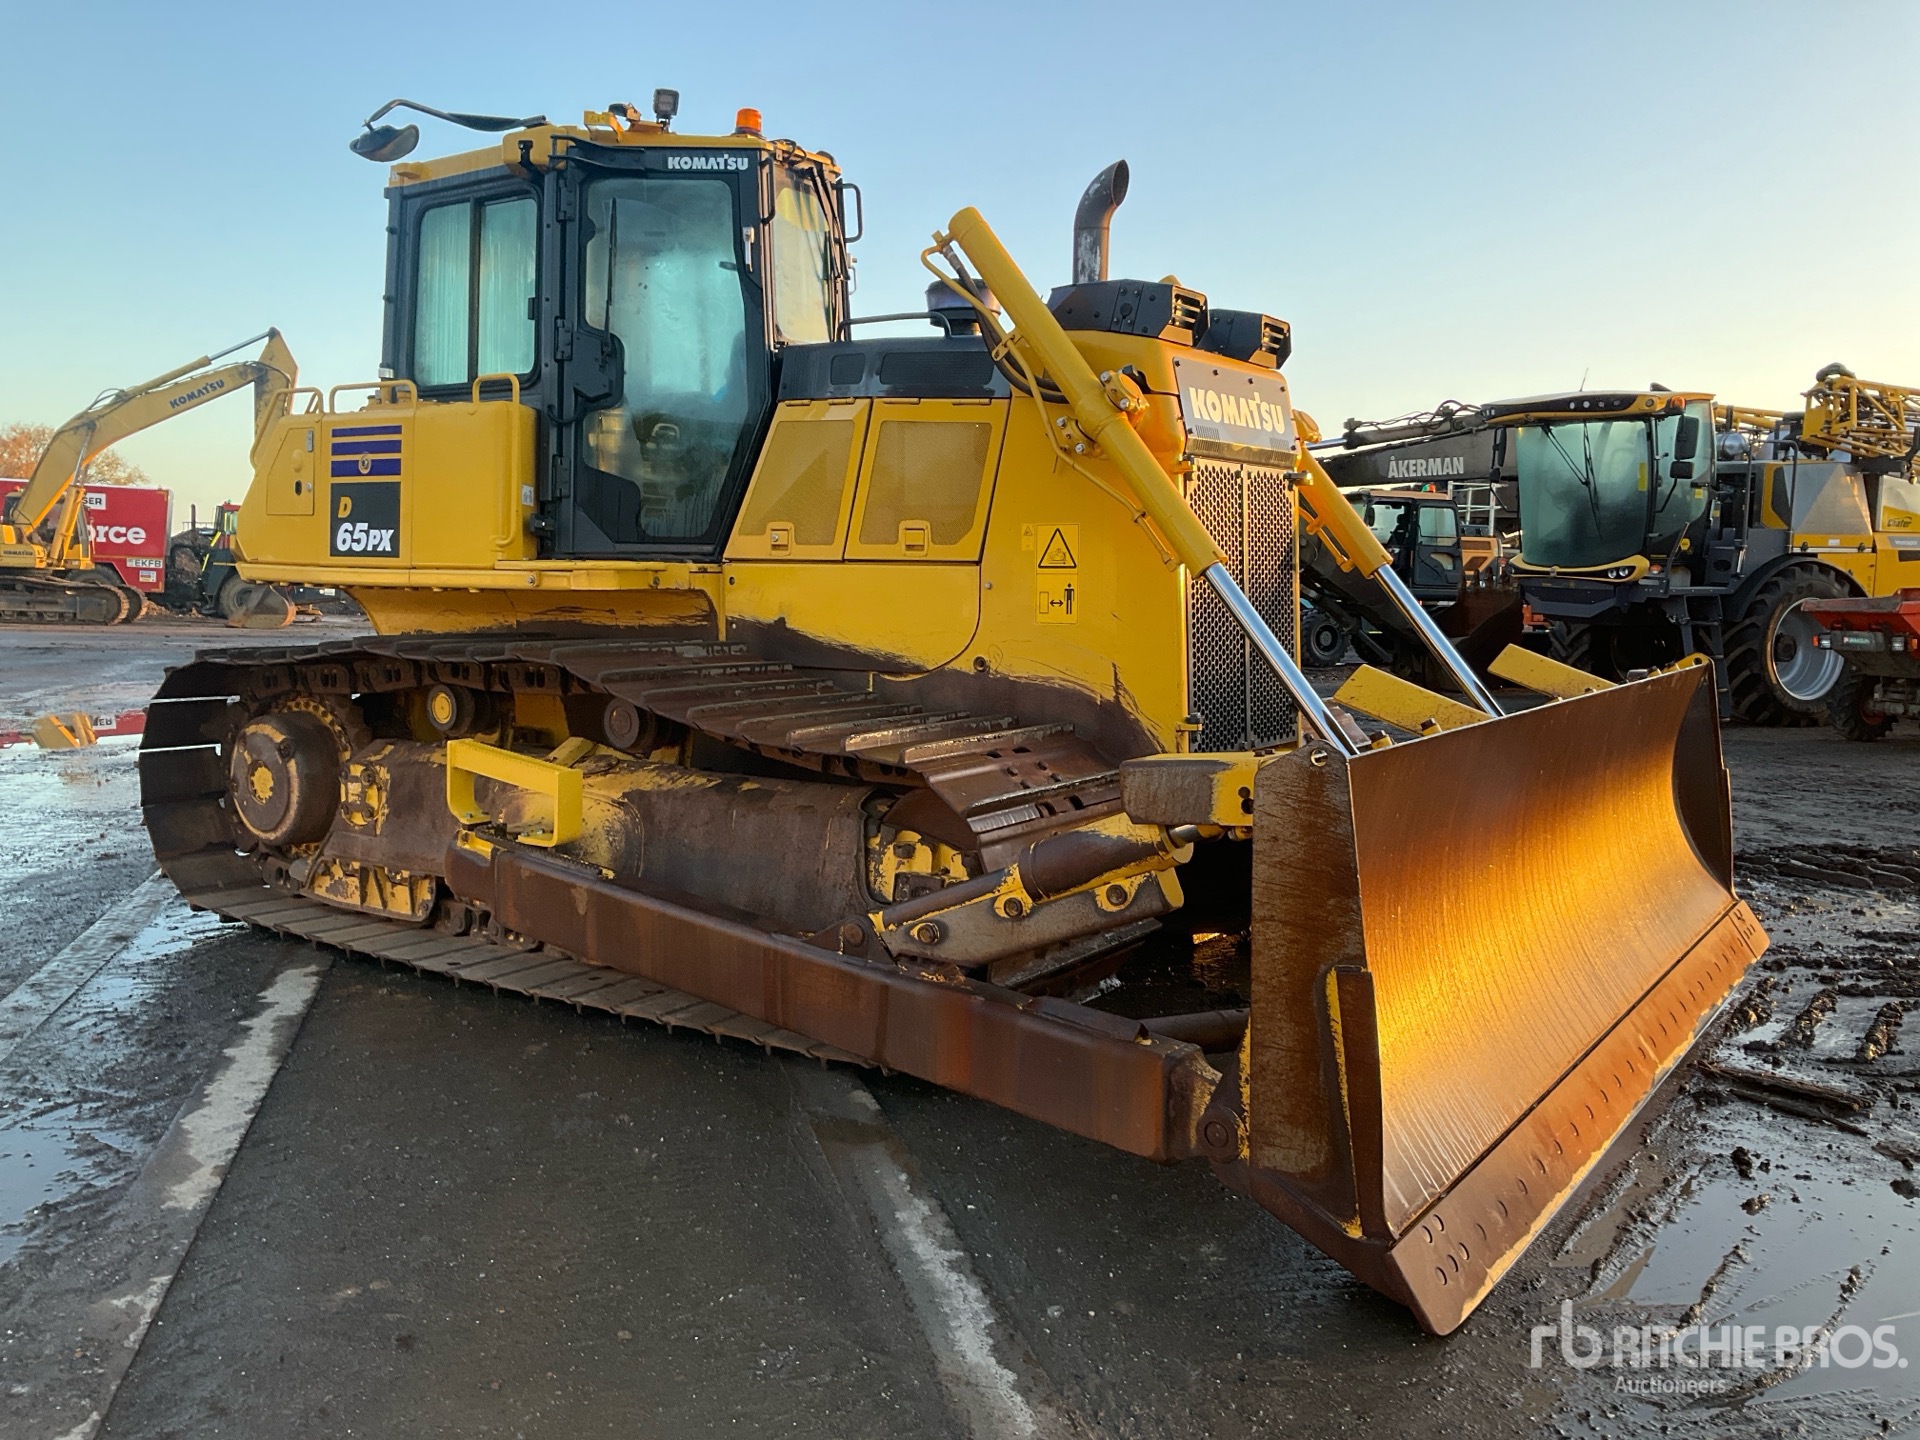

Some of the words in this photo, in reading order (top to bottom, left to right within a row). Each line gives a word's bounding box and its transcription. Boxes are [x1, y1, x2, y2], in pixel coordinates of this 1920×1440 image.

[667, 154, 749, 170] KOMATSU
[169, 379, 225, 409] KOMATSU
[1189, 386, 1286, 434] KOMATSU
[1388, 455, 1464, 478] ÅKERMAN
[337, 496, 352, 518] D
[336, 522, 395, 552] 65PX
